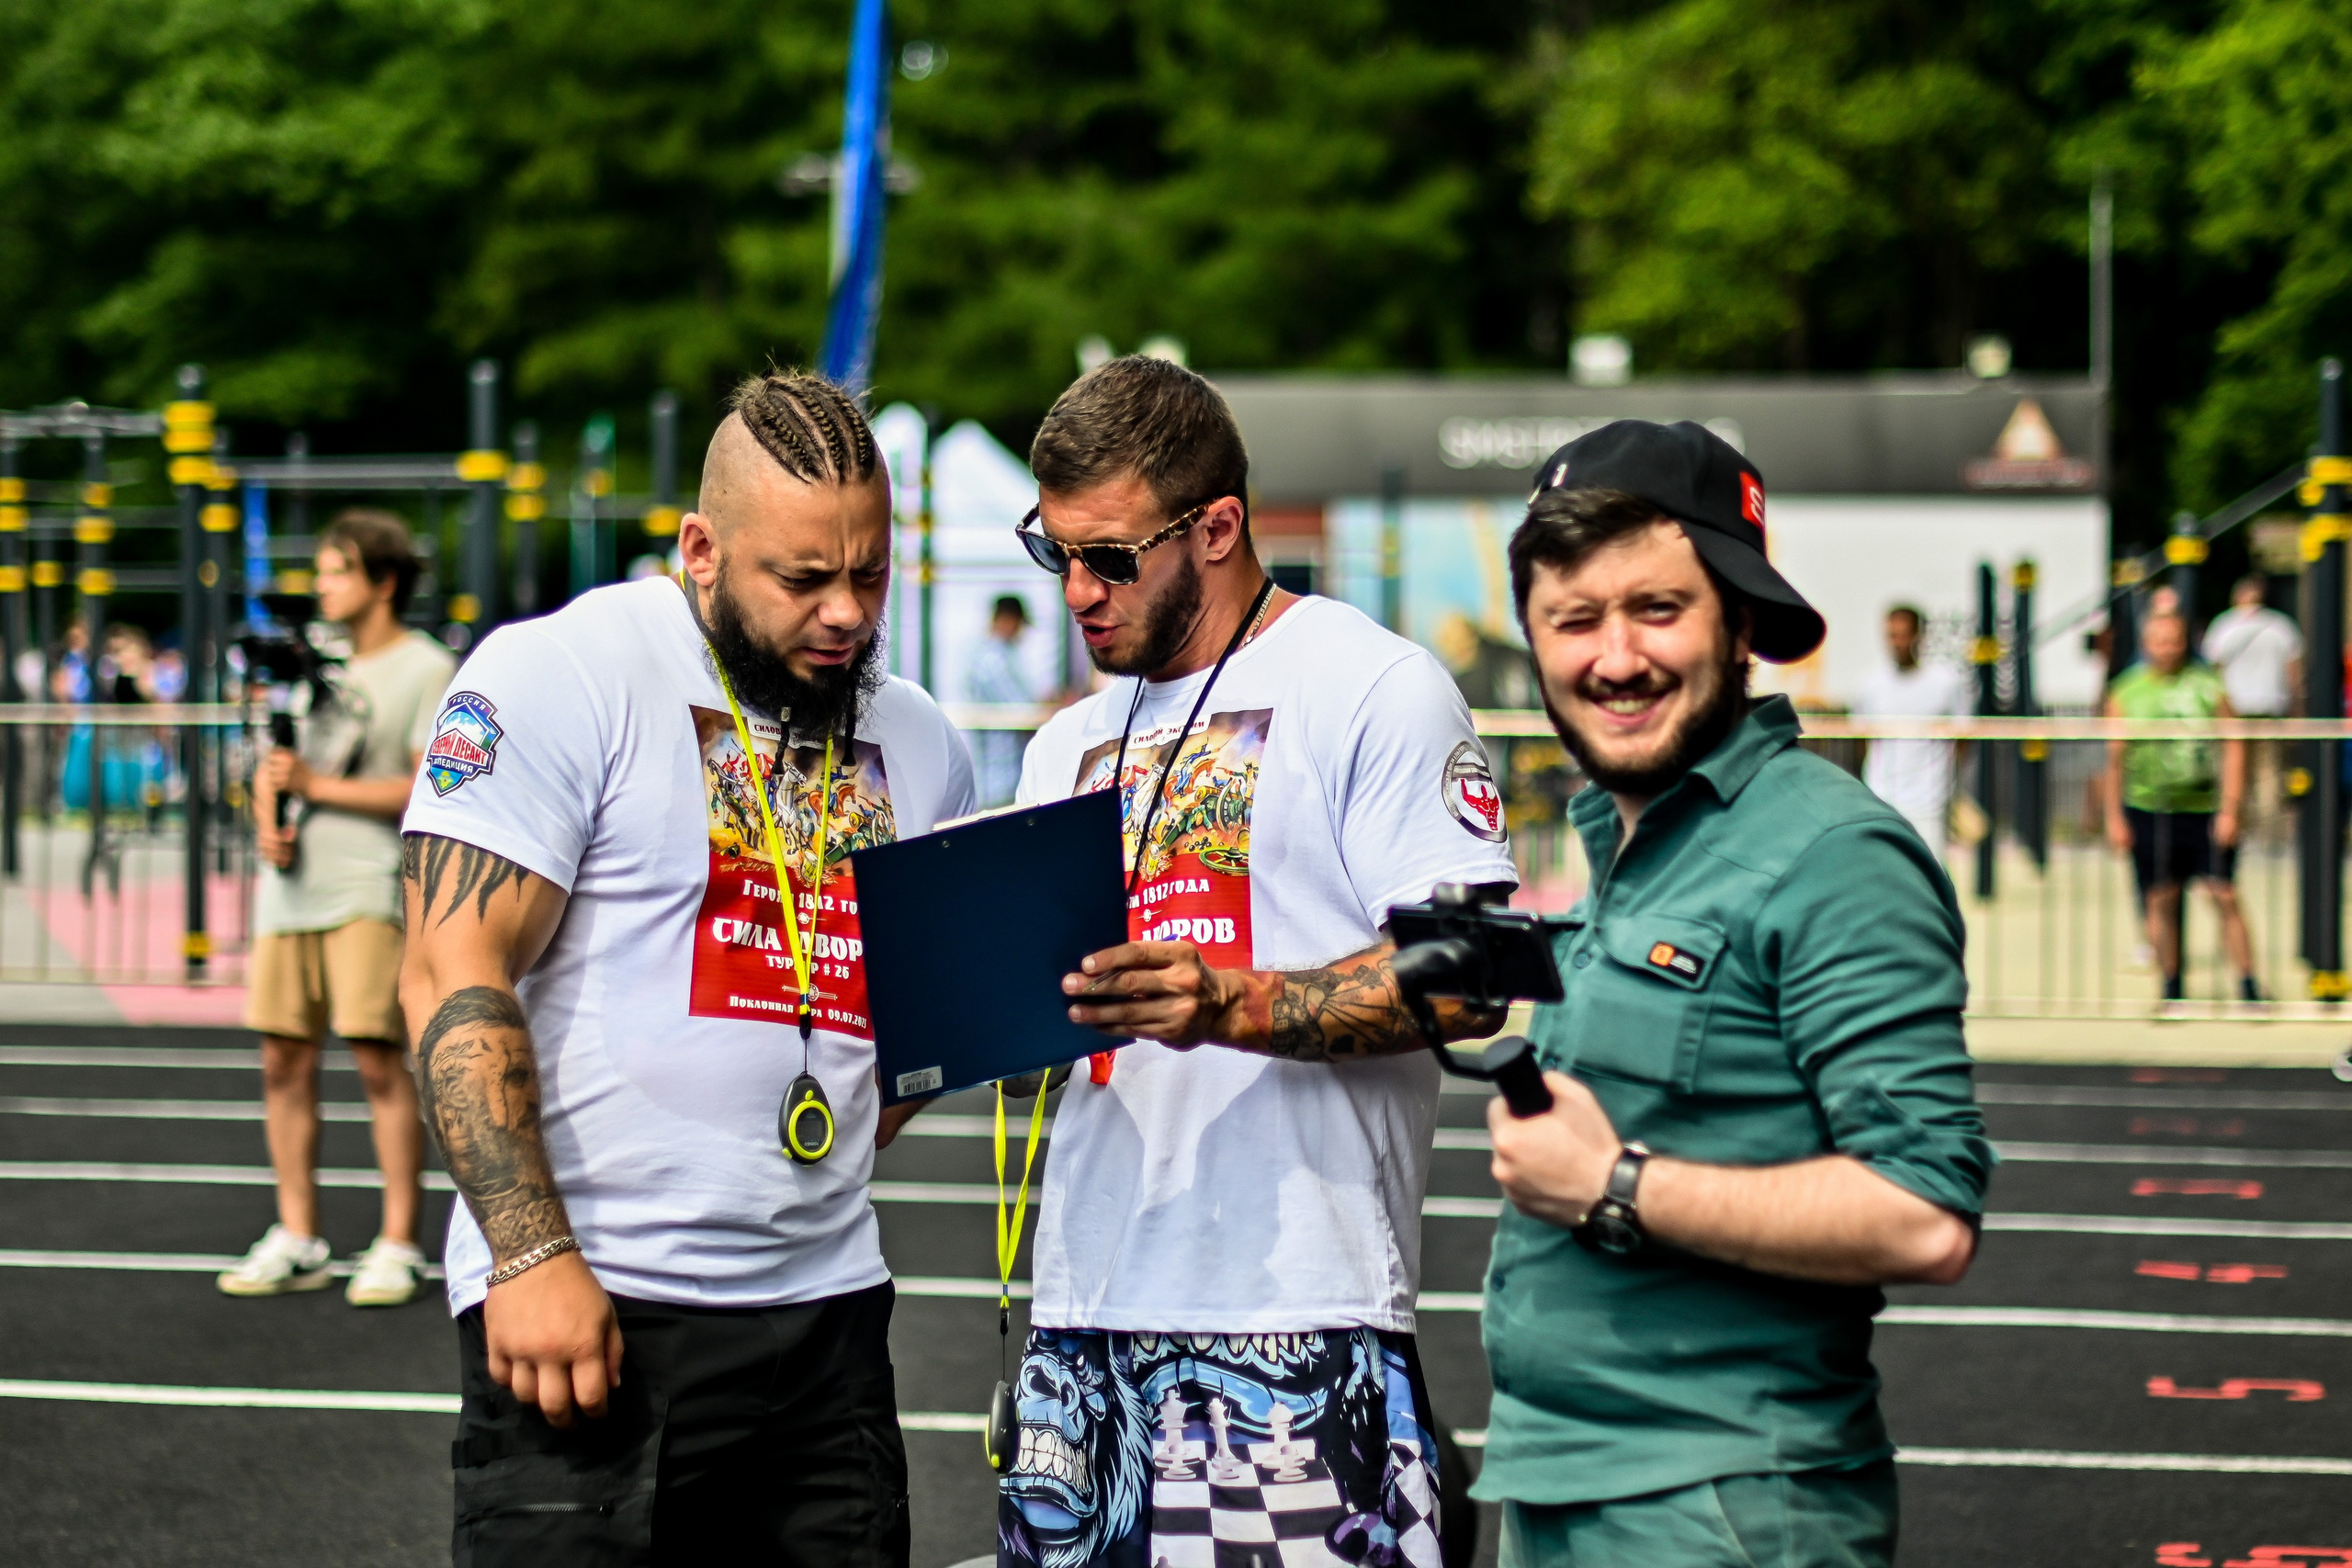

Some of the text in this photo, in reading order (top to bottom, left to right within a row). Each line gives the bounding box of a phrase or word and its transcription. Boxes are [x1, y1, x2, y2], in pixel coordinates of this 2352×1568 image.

[452, 696, 486, 711] РОССИЯ
[754, 724, 782, 736] СИЛОВ
[1167, 721, 1204, 736] ЭКСИМ
[452, 736, 487, 765] ДЕСАНТ
[434, 757, 474, 773] ПЕДИЦИЯ
[1142, 882, 1169, 906] 1812
[1169, 878, 1210, 896] ГОДА
[840, 899, 858, 916] ГО
[712, 917, 864, 963] СИЛА ДВОР
[765, 954, 851, 980] ТУРР # 26
[810, 1008, 823, 1019] РА
[2146, 1376, 2326, 1401] 5
